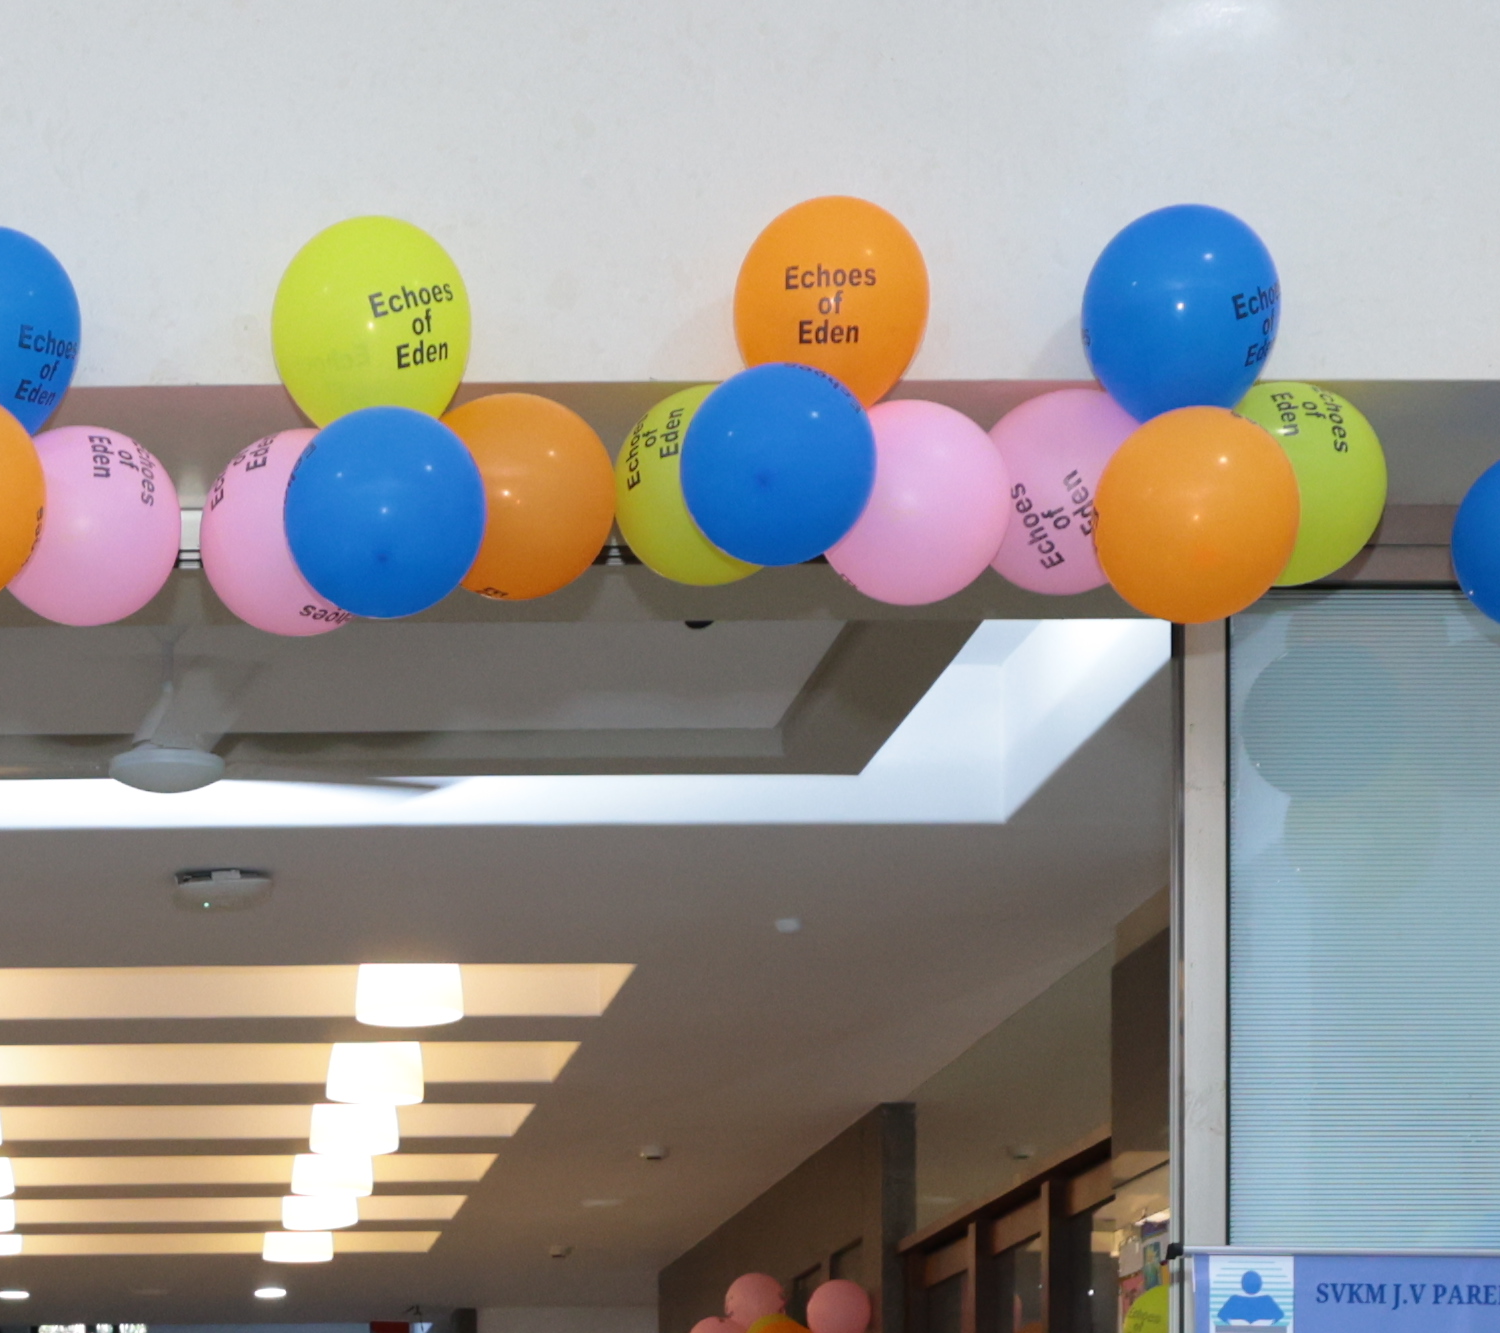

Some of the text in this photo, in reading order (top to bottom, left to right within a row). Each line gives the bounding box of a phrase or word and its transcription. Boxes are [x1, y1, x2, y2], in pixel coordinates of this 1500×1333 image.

[785, 265, 876, 291] Echoes
[369, 279, 454, 318] Echoes
[819, 292, 842, 315] of
[411, 310, 433, 335] of
[798, 319, 859, 345] Eden
[397, 339, 448, 370] Eden
[1316, 1282, 1387, 1305] SVKM
[1392, 1282, 1427, 1311] J.V
